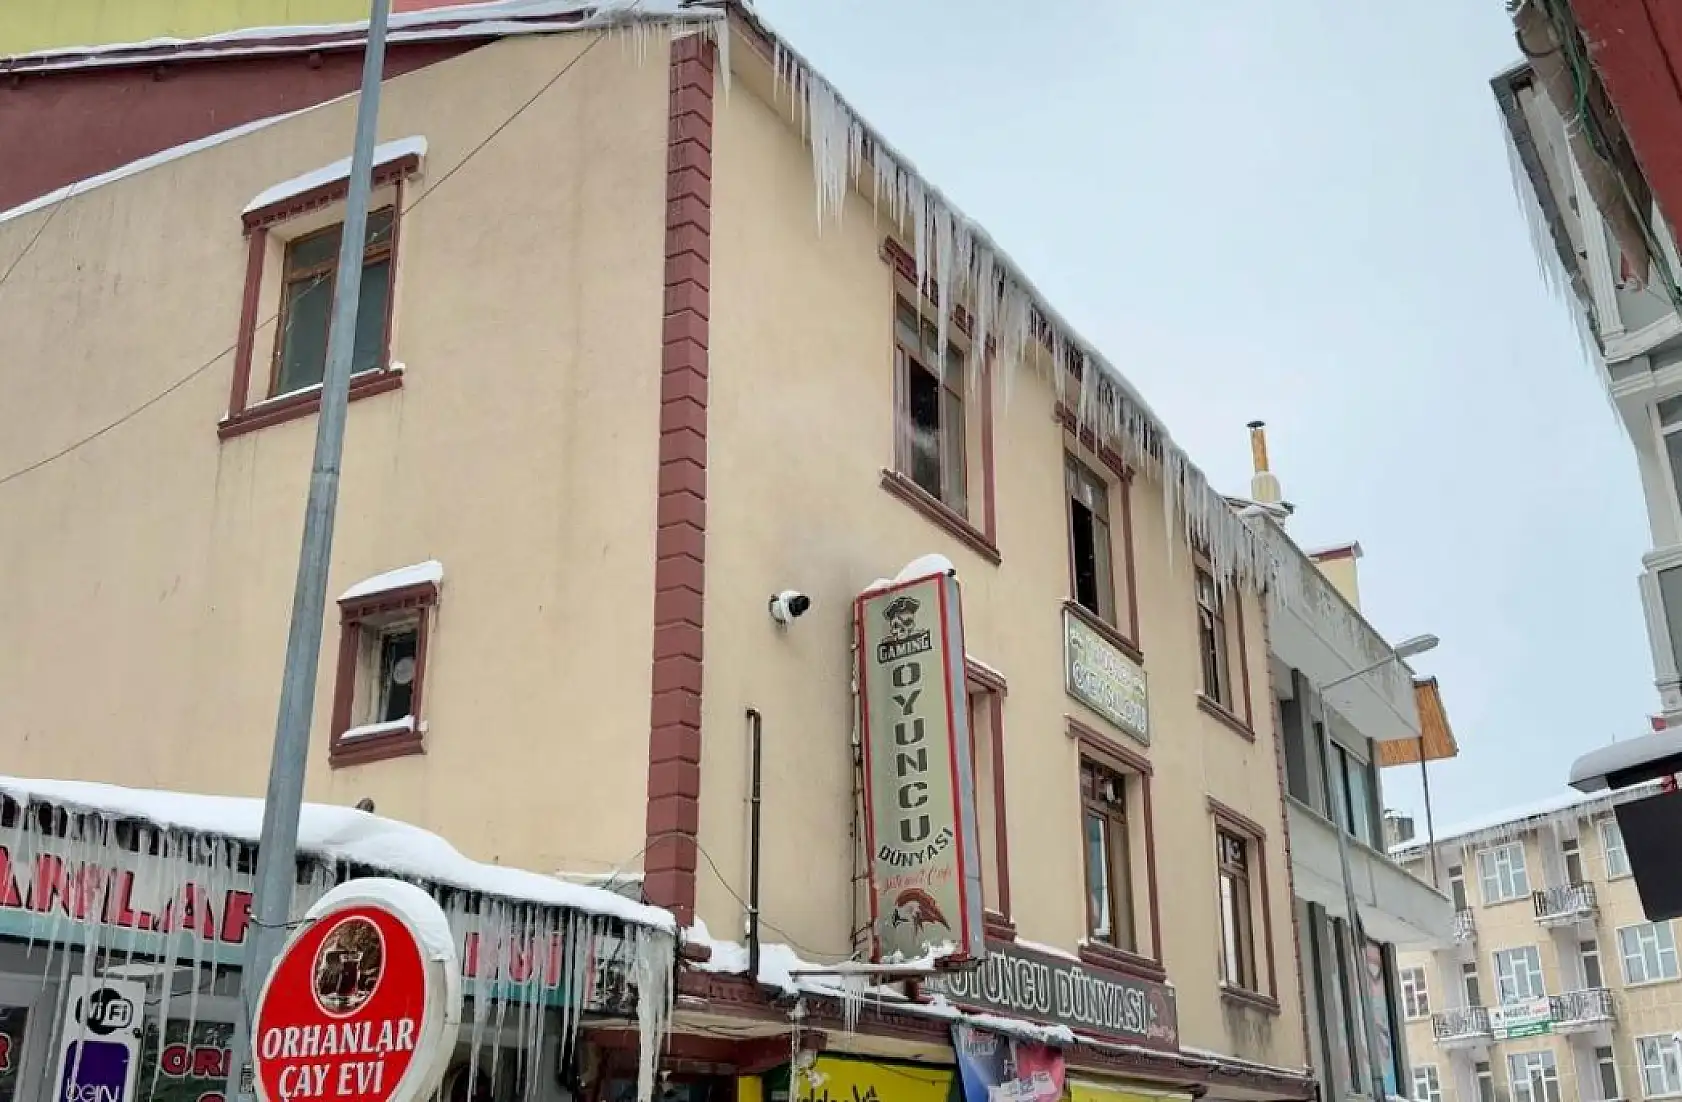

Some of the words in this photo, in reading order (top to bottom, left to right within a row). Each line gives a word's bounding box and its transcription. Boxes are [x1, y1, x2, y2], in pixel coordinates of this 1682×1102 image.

[880, 636, 931, 662] GAMING
[893, 662, 931, 843] OYUNCU
[1054, 966, 1147, 1034] DÜNYASI
[262, 1018, 415, 1060] ORHANLAR
[279, 1063, 331, 1102] ÇAY
[337, 1052, 385, 1096] EVİ
